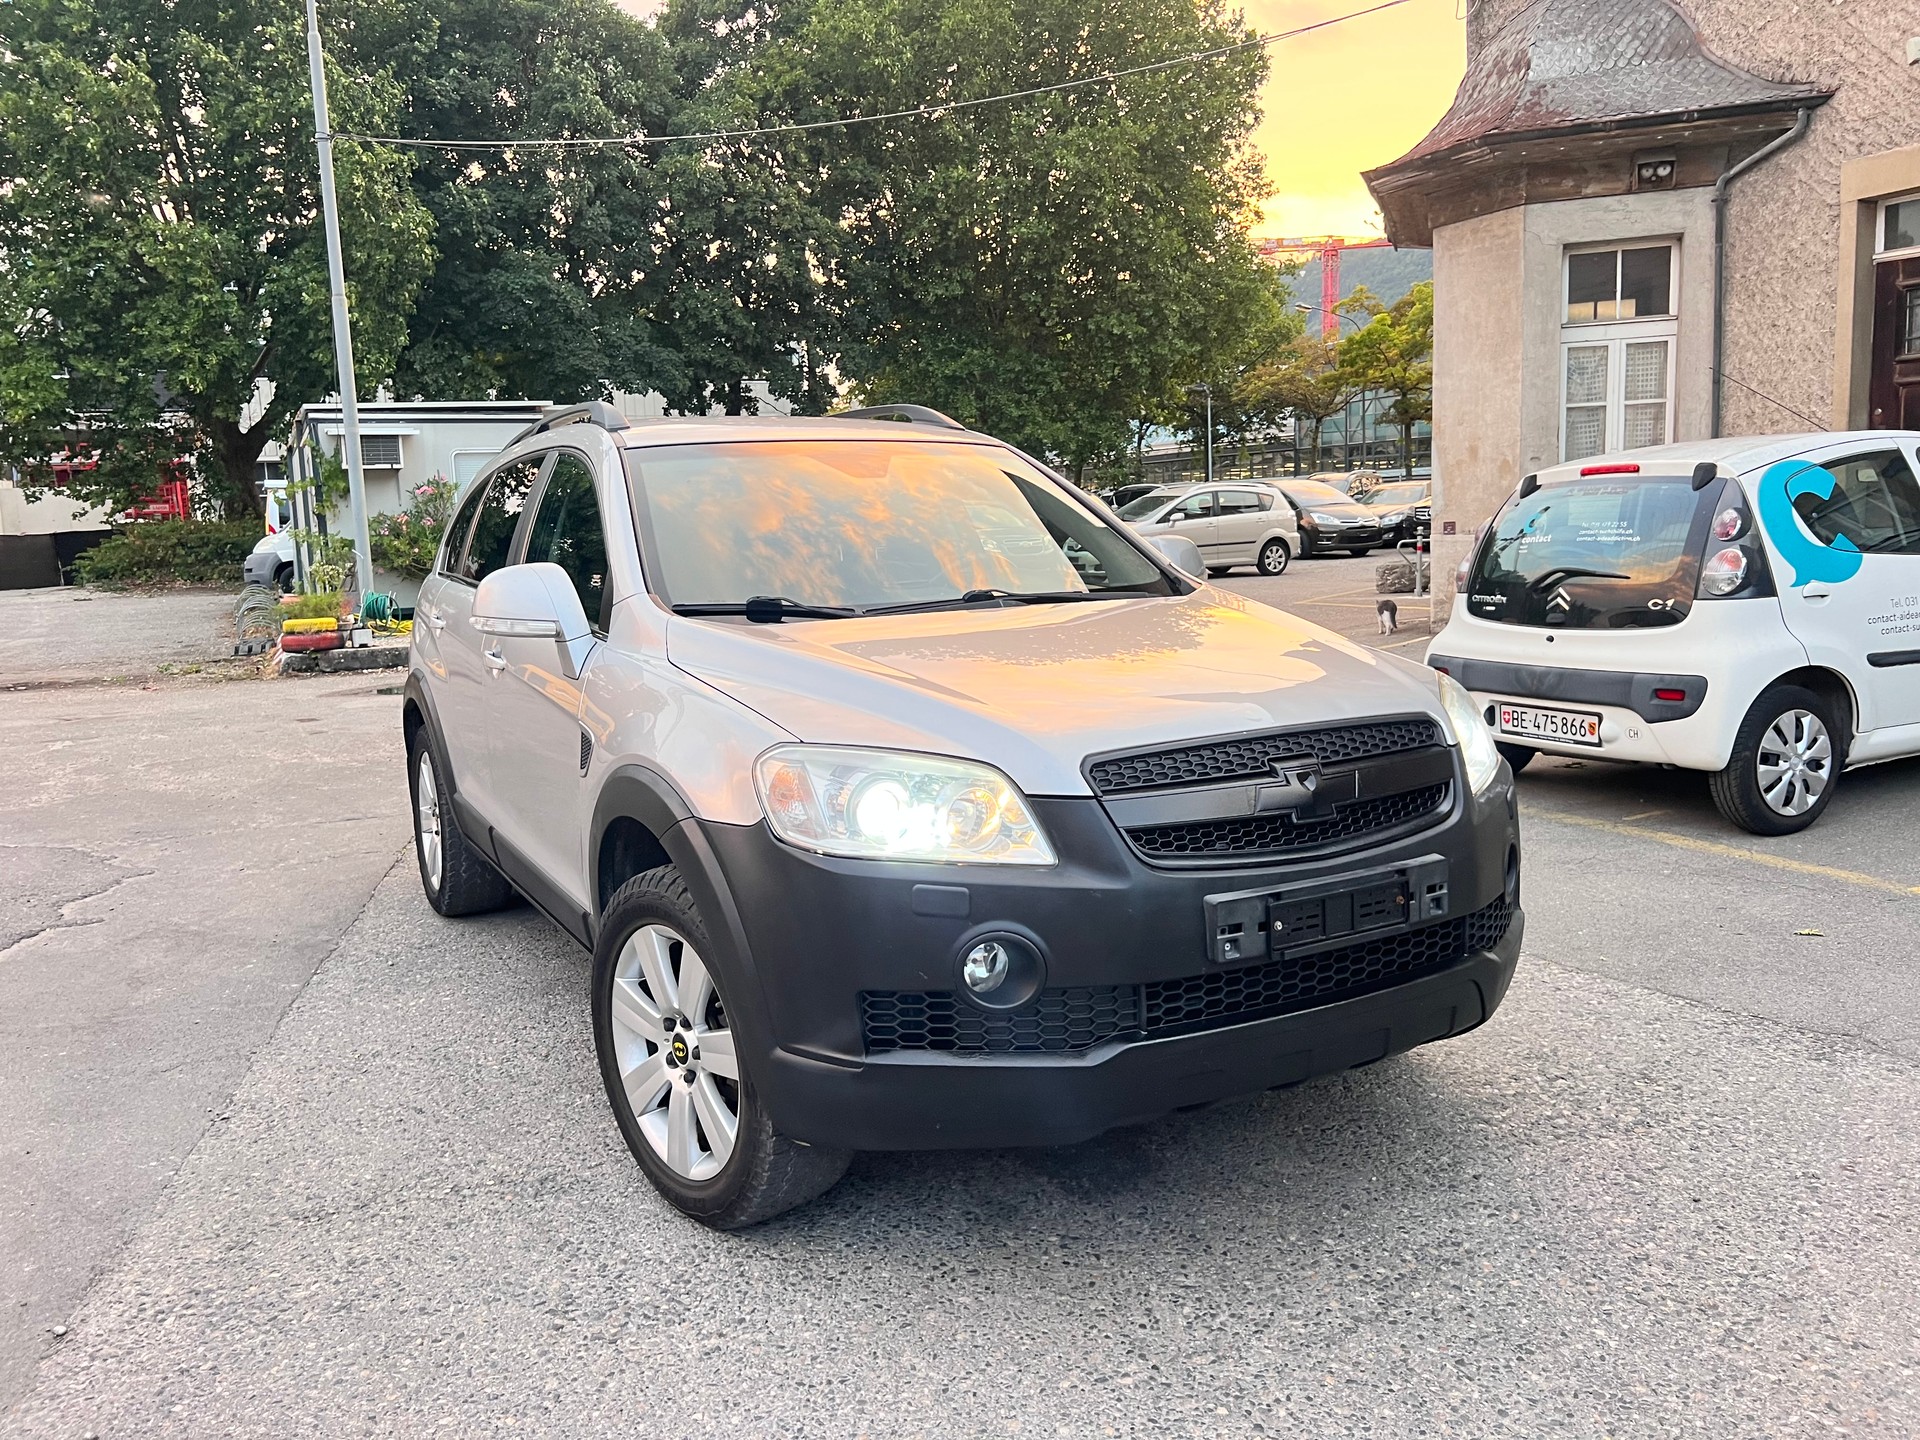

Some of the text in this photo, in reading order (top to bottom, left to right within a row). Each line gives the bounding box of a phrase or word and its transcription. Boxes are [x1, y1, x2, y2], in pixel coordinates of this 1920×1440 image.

[1521, 534, 1552, 544] contact
[1647, 598, 1675, 610] C1
[1904, 596, 1918, 607] 031
[1867, 610, 1920, 625] contact-aidea
[1628, 729, 1639, 739] CH
